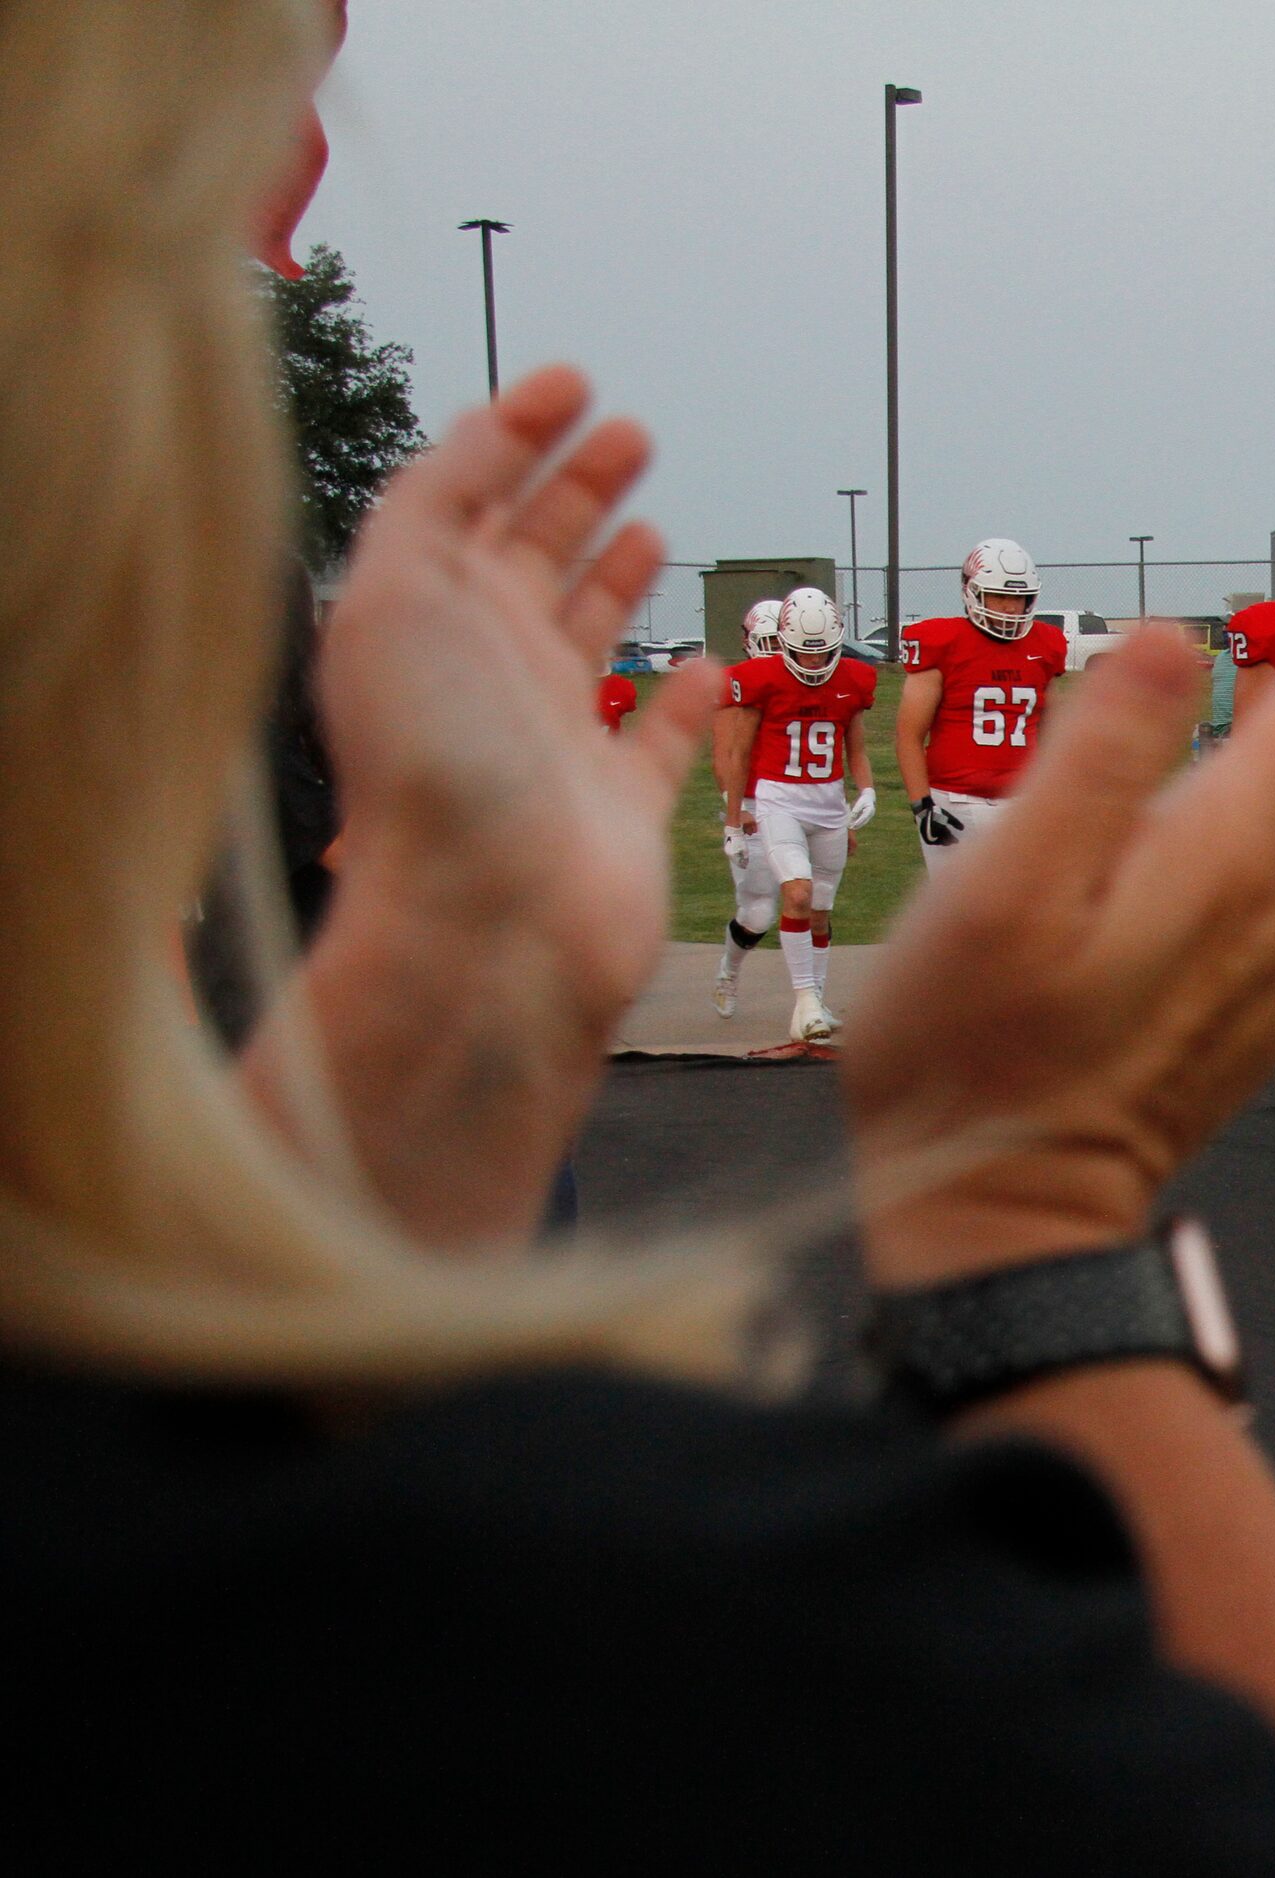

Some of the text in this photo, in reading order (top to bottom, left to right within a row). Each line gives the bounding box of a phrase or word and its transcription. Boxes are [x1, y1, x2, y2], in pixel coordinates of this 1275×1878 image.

[899, 640, 921, 665] 67
[972, 686, 1038, 747] 67
[783, 720, 836, 779] 19
